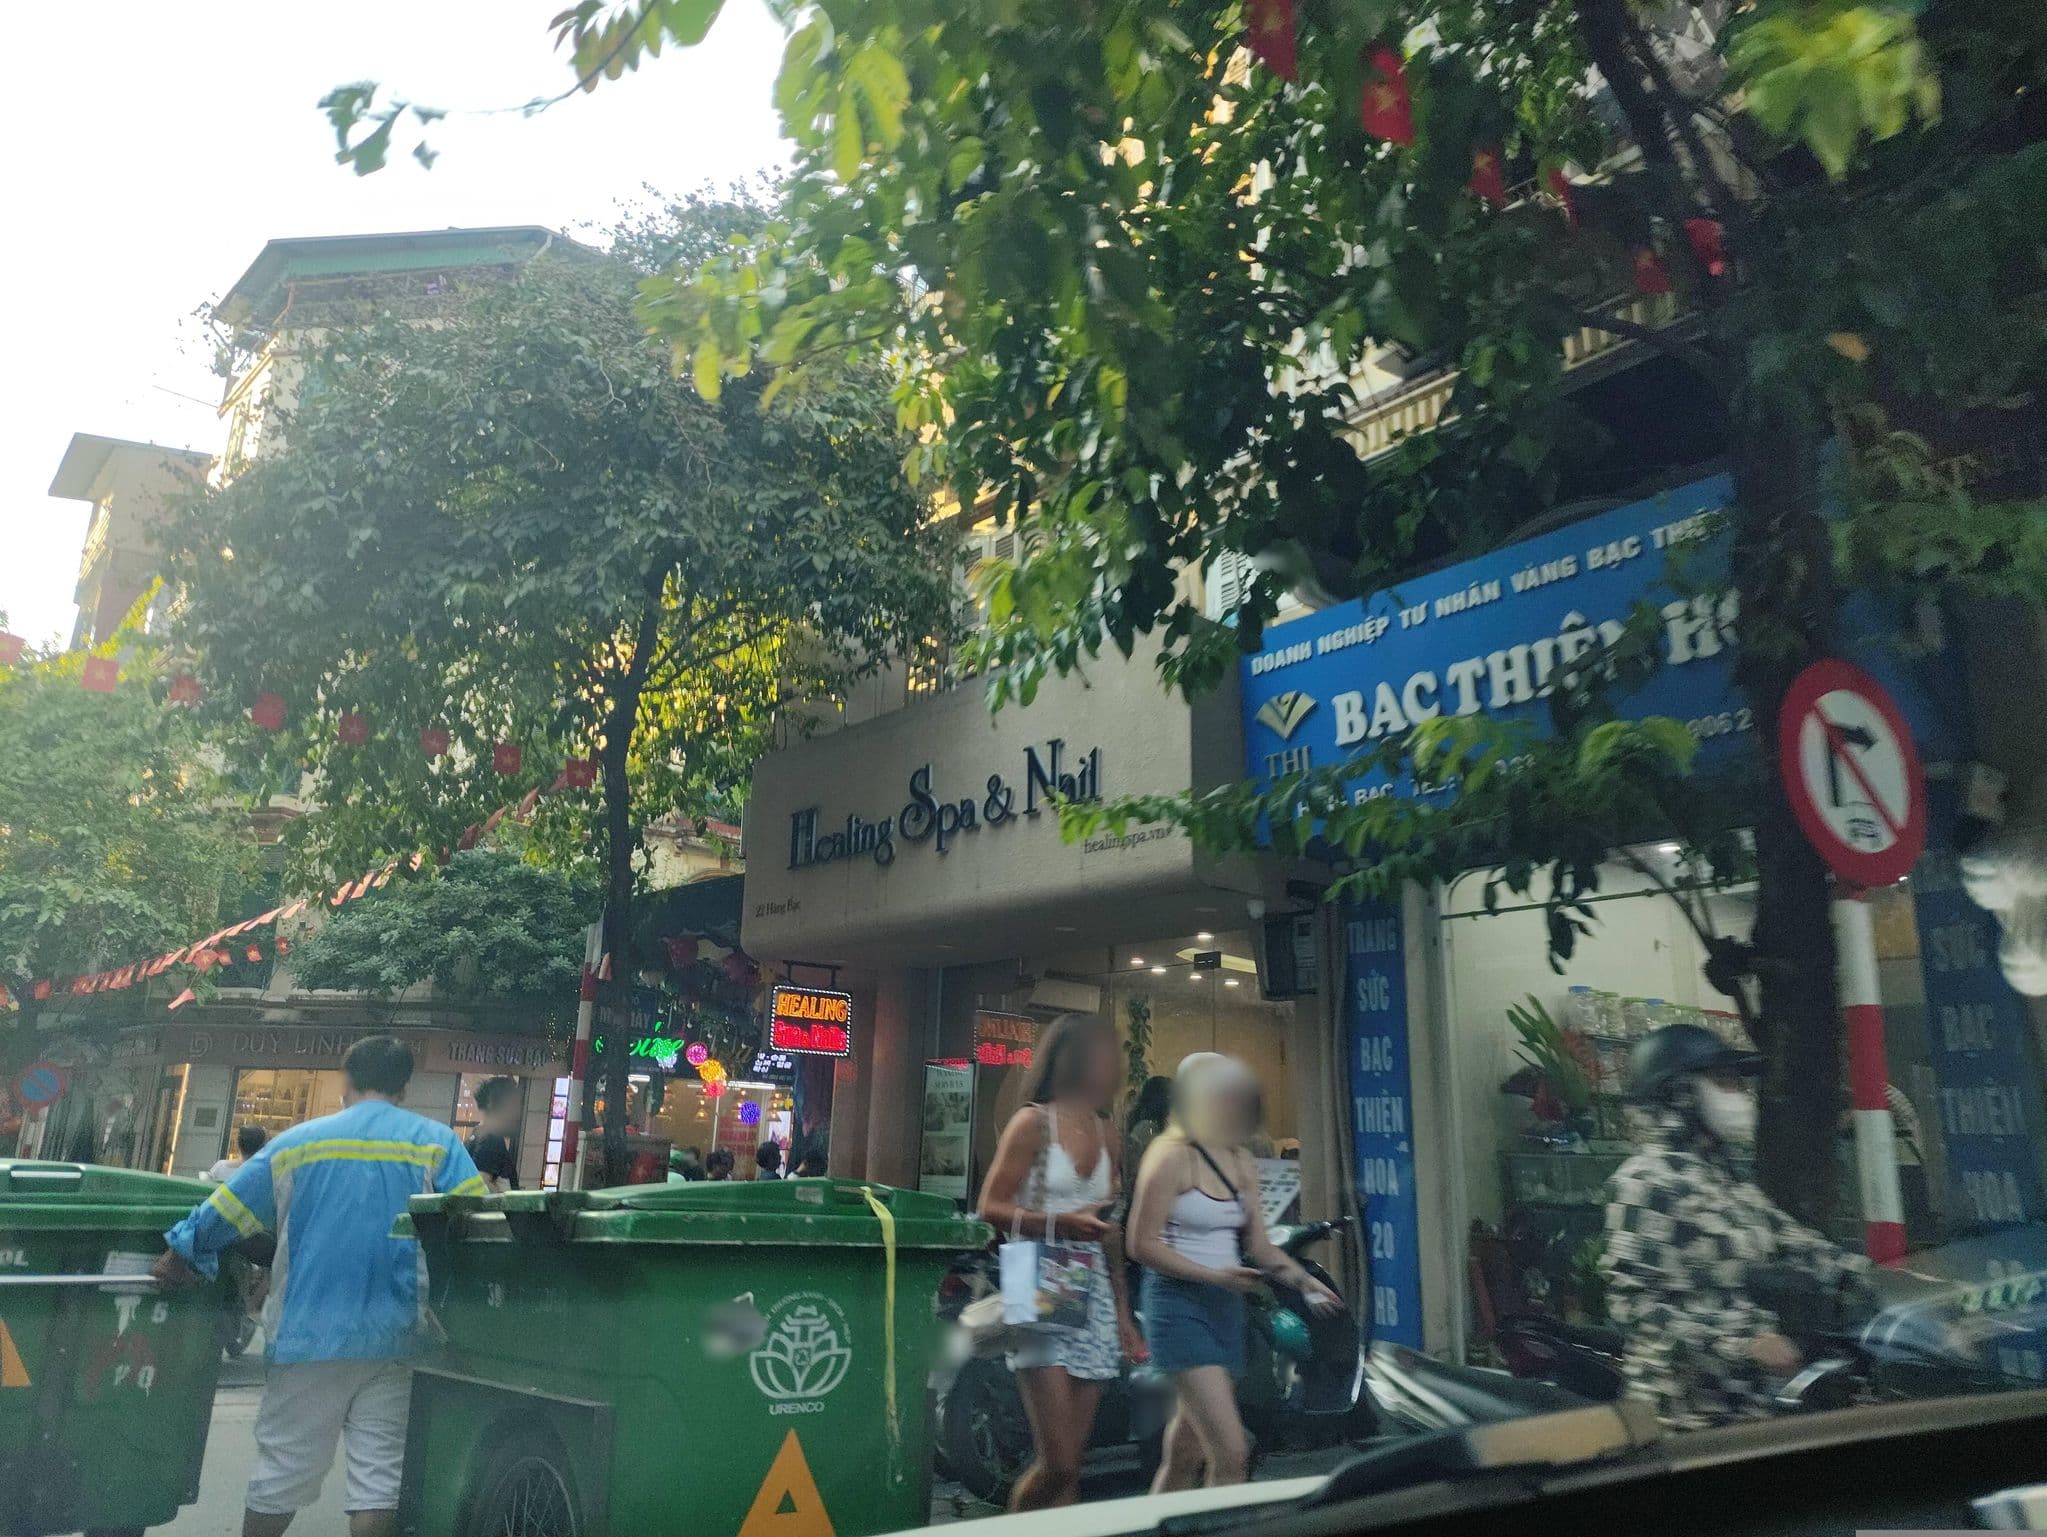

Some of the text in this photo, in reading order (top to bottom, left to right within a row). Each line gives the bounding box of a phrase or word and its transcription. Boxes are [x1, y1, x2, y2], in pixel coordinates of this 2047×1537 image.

[1251, 640, 1313, 677] DOANH
[1585, 534, 1643, 572] BẠC
[787, 737, 1103, 871] Healing Spa & Nail
[775, 991, 849, 1022] HEALING
[1360, 1036, 1394, 1077] BẠC
[1354, 1088, 1405, 1139] THIỆN
[1364, 1157, 1400, 1196] HOA
[1372, 1220, 1396, 1260] 20
[1373, 1285, 1400, 1326] HB
[768, 1401, 826, 1416] URENCO
